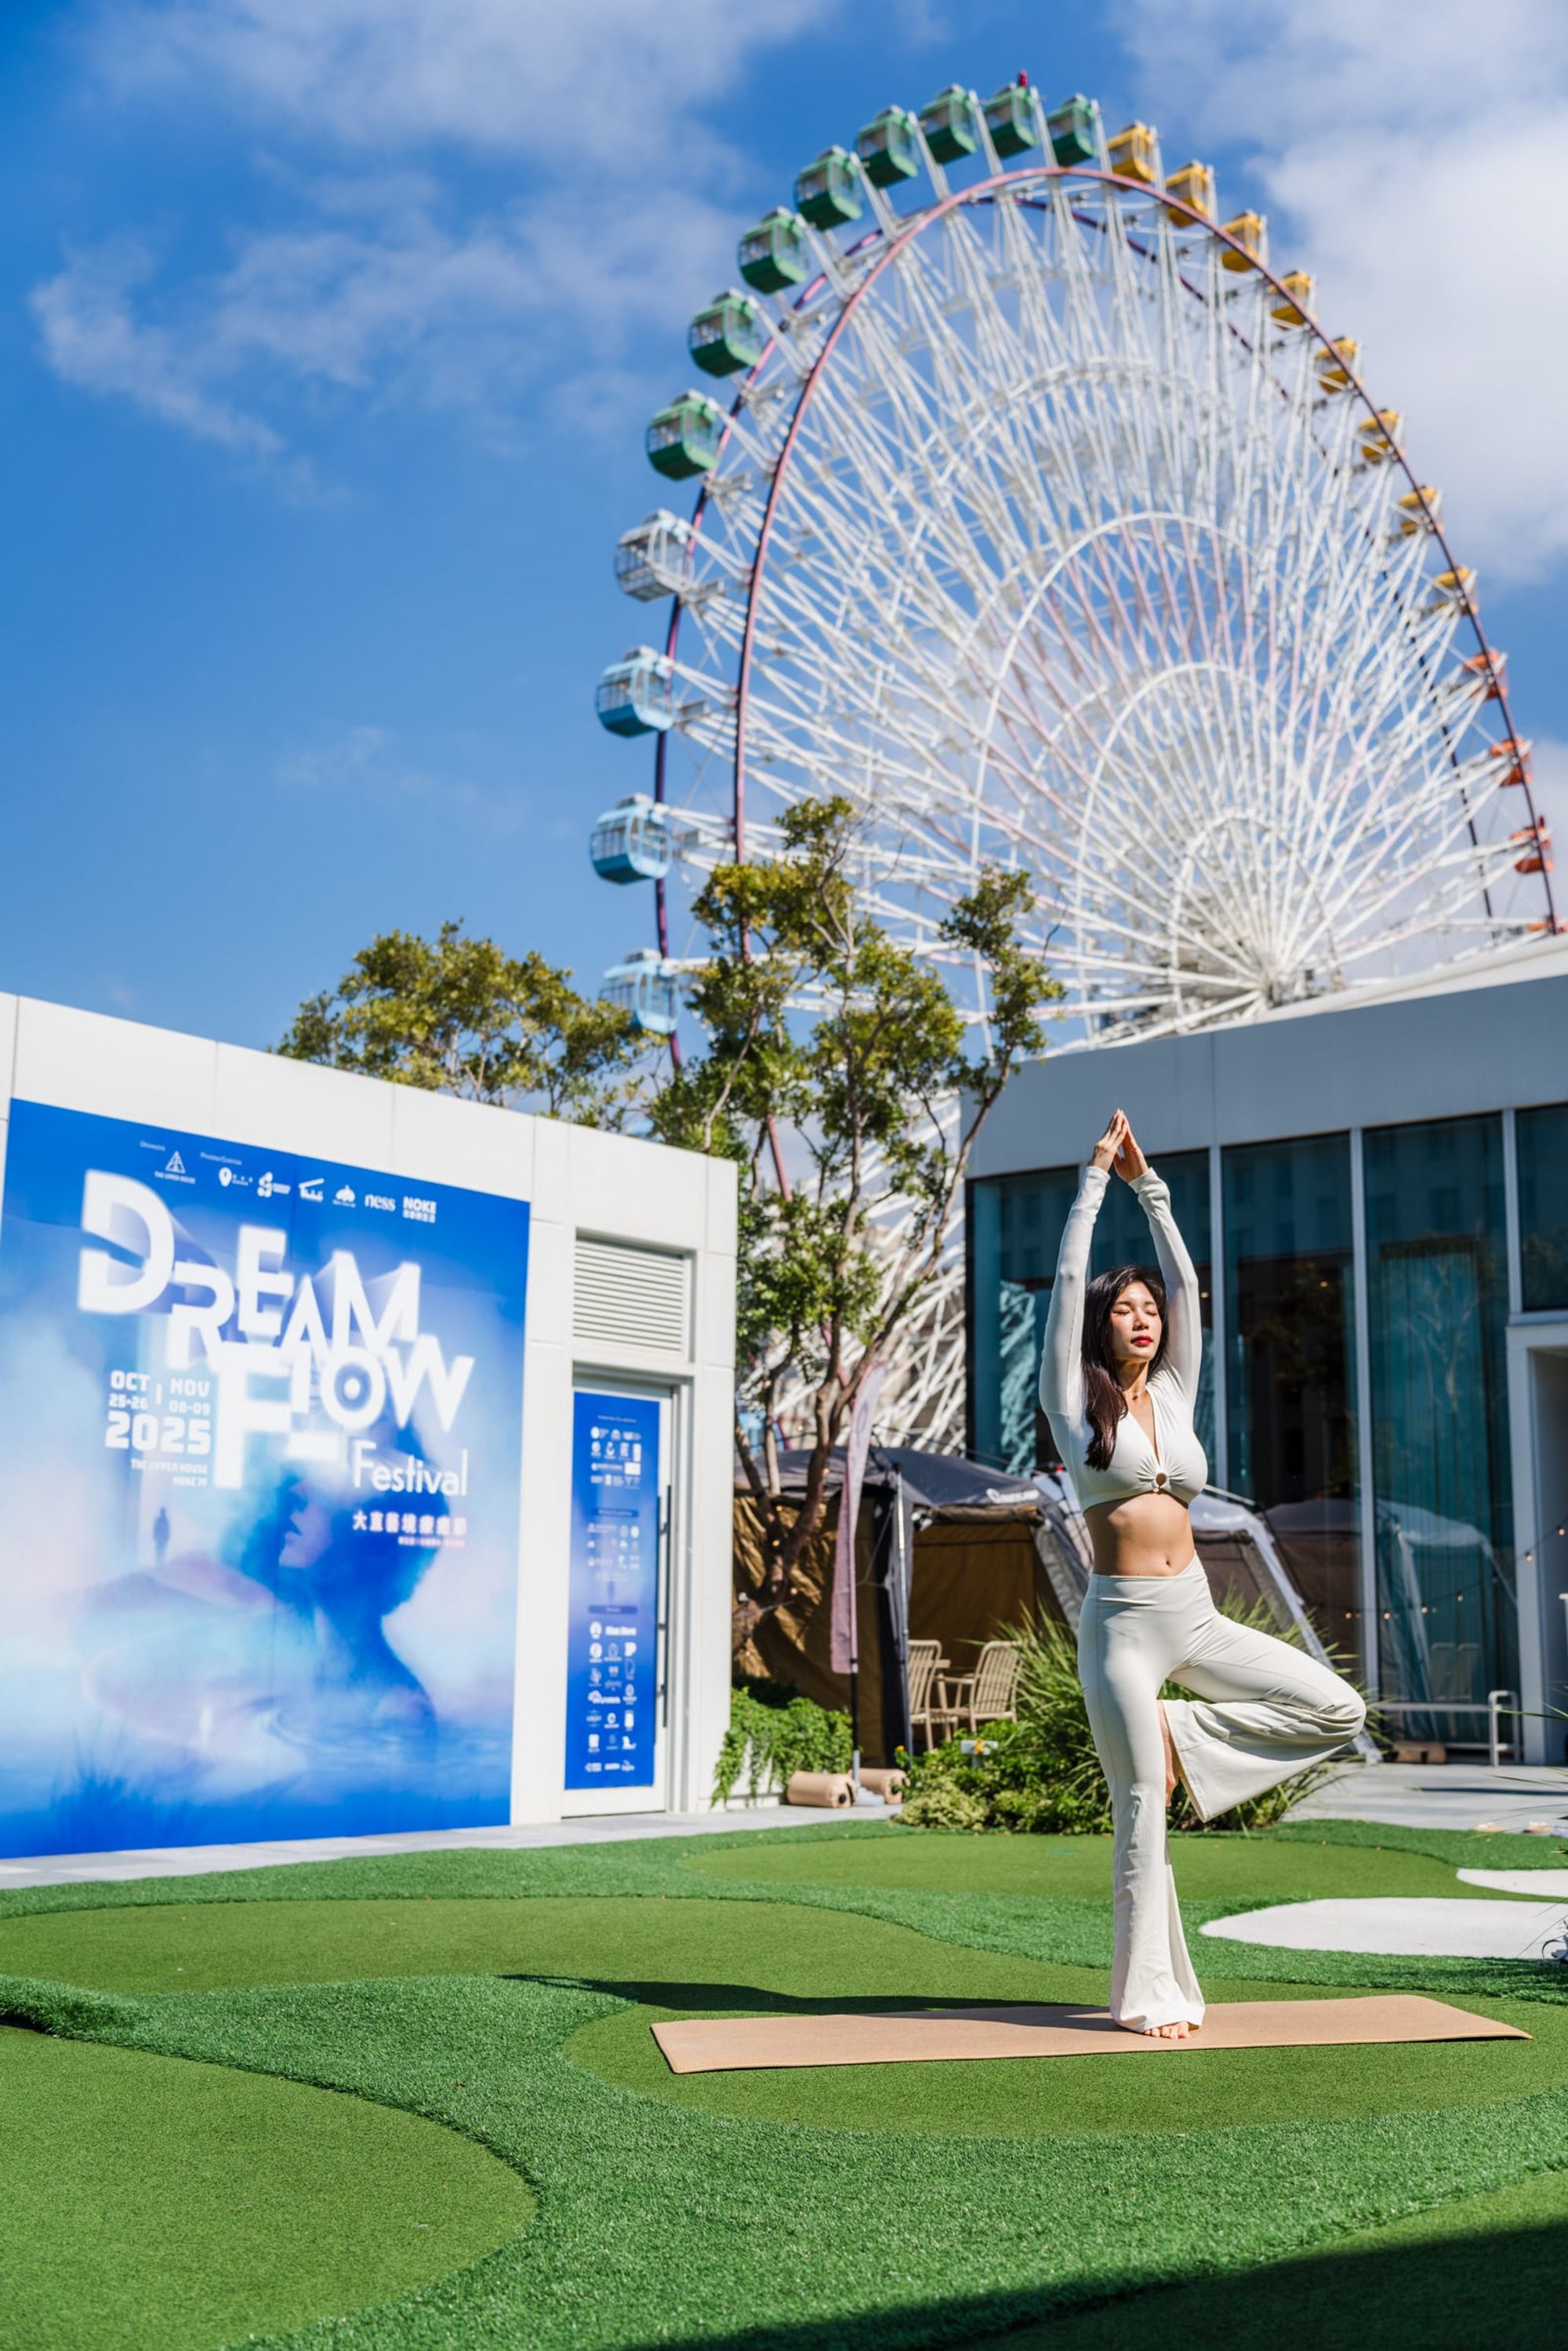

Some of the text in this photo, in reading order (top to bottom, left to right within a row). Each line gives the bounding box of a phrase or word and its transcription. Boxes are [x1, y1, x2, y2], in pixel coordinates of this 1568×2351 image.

[365, 1194, 396, 1212] ness
[402, 1196, 437, 1215] NOKE
[78, 1168, 421, 1372] DREAM
[110, 1370, 150, 1392] OCT
[169, 1378, 210, 1397] NOV
[108, 1393, 149, 1410] 25-26
[169, 1400, 211, 1415] 08-09
[209, 1333, 475, 1488] FLOW
[104, 1410, 211, 1455] 2025
[353, 1439, 468, 1496] Festival
